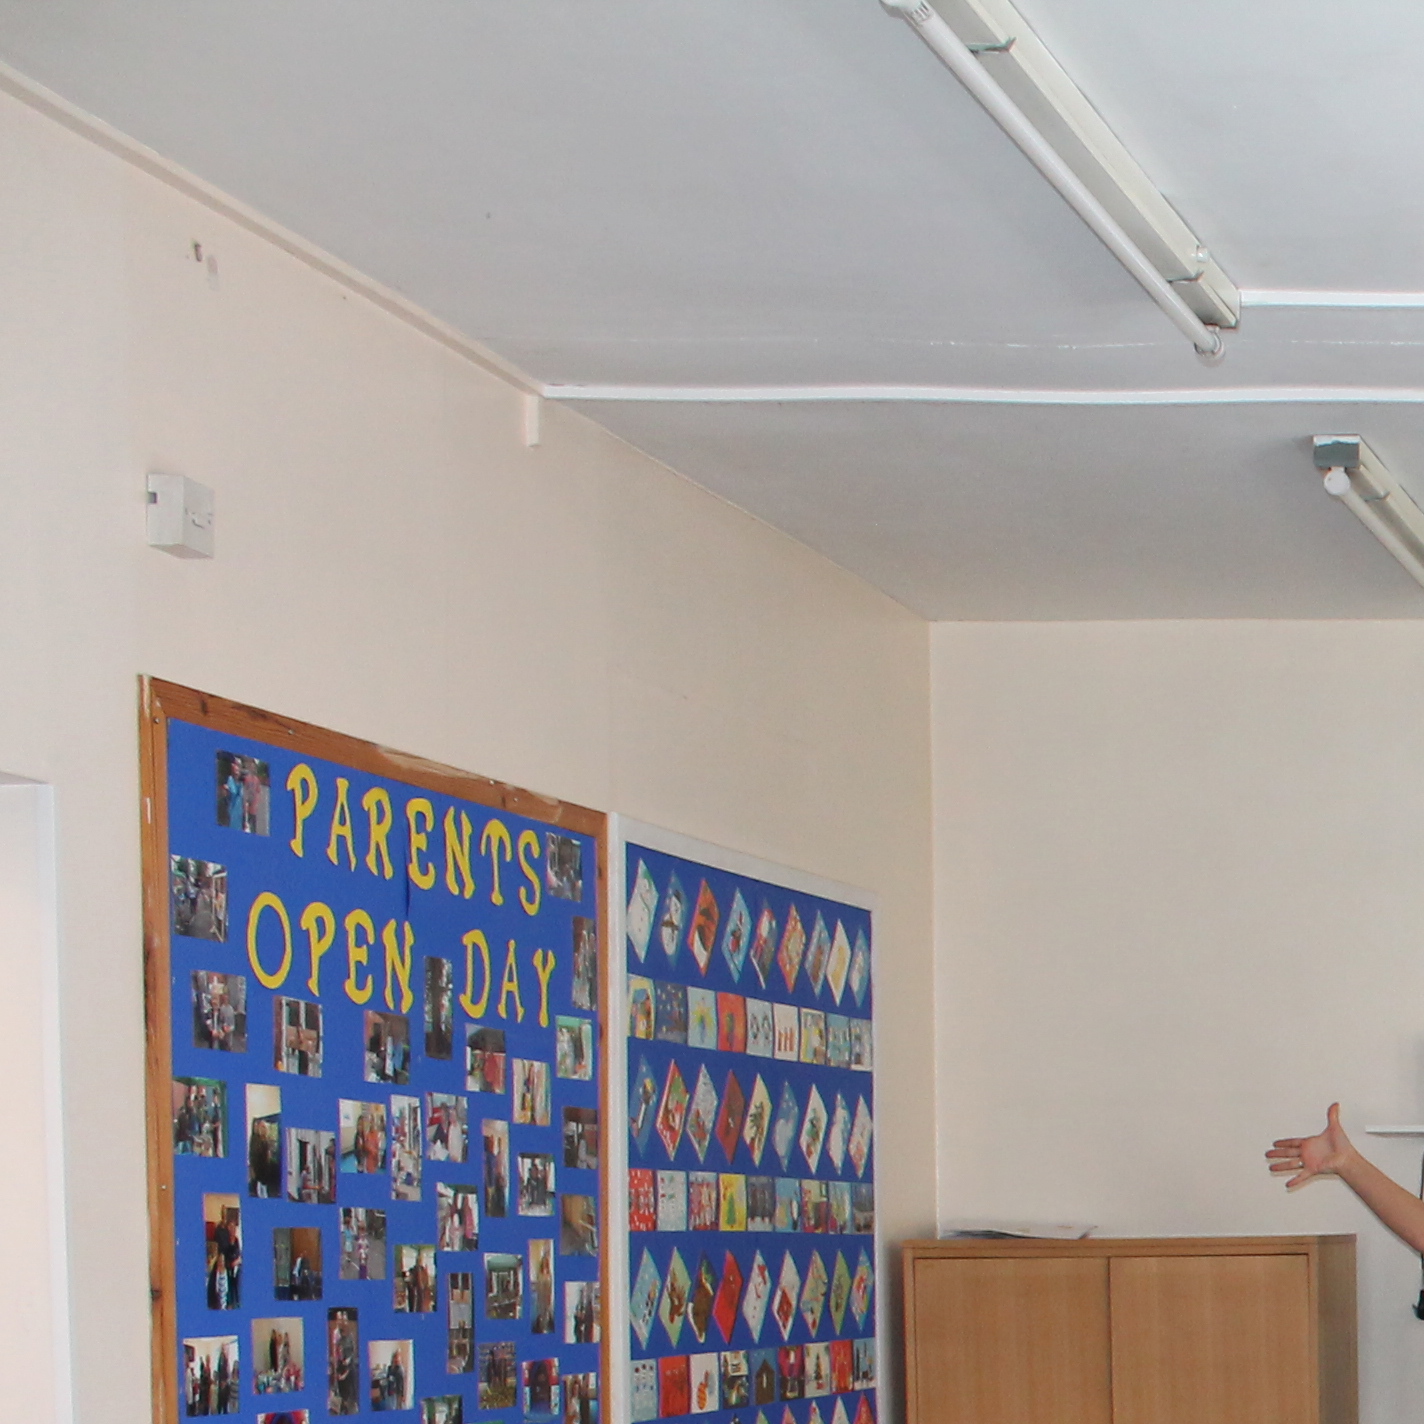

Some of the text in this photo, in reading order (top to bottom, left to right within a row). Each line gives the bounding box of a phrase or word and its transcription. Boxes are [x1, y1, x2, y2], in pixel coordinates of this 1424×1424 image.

[286, 763, 542, 916] PARENTS
[246, 891, 556, 1028] OPEN DAY
